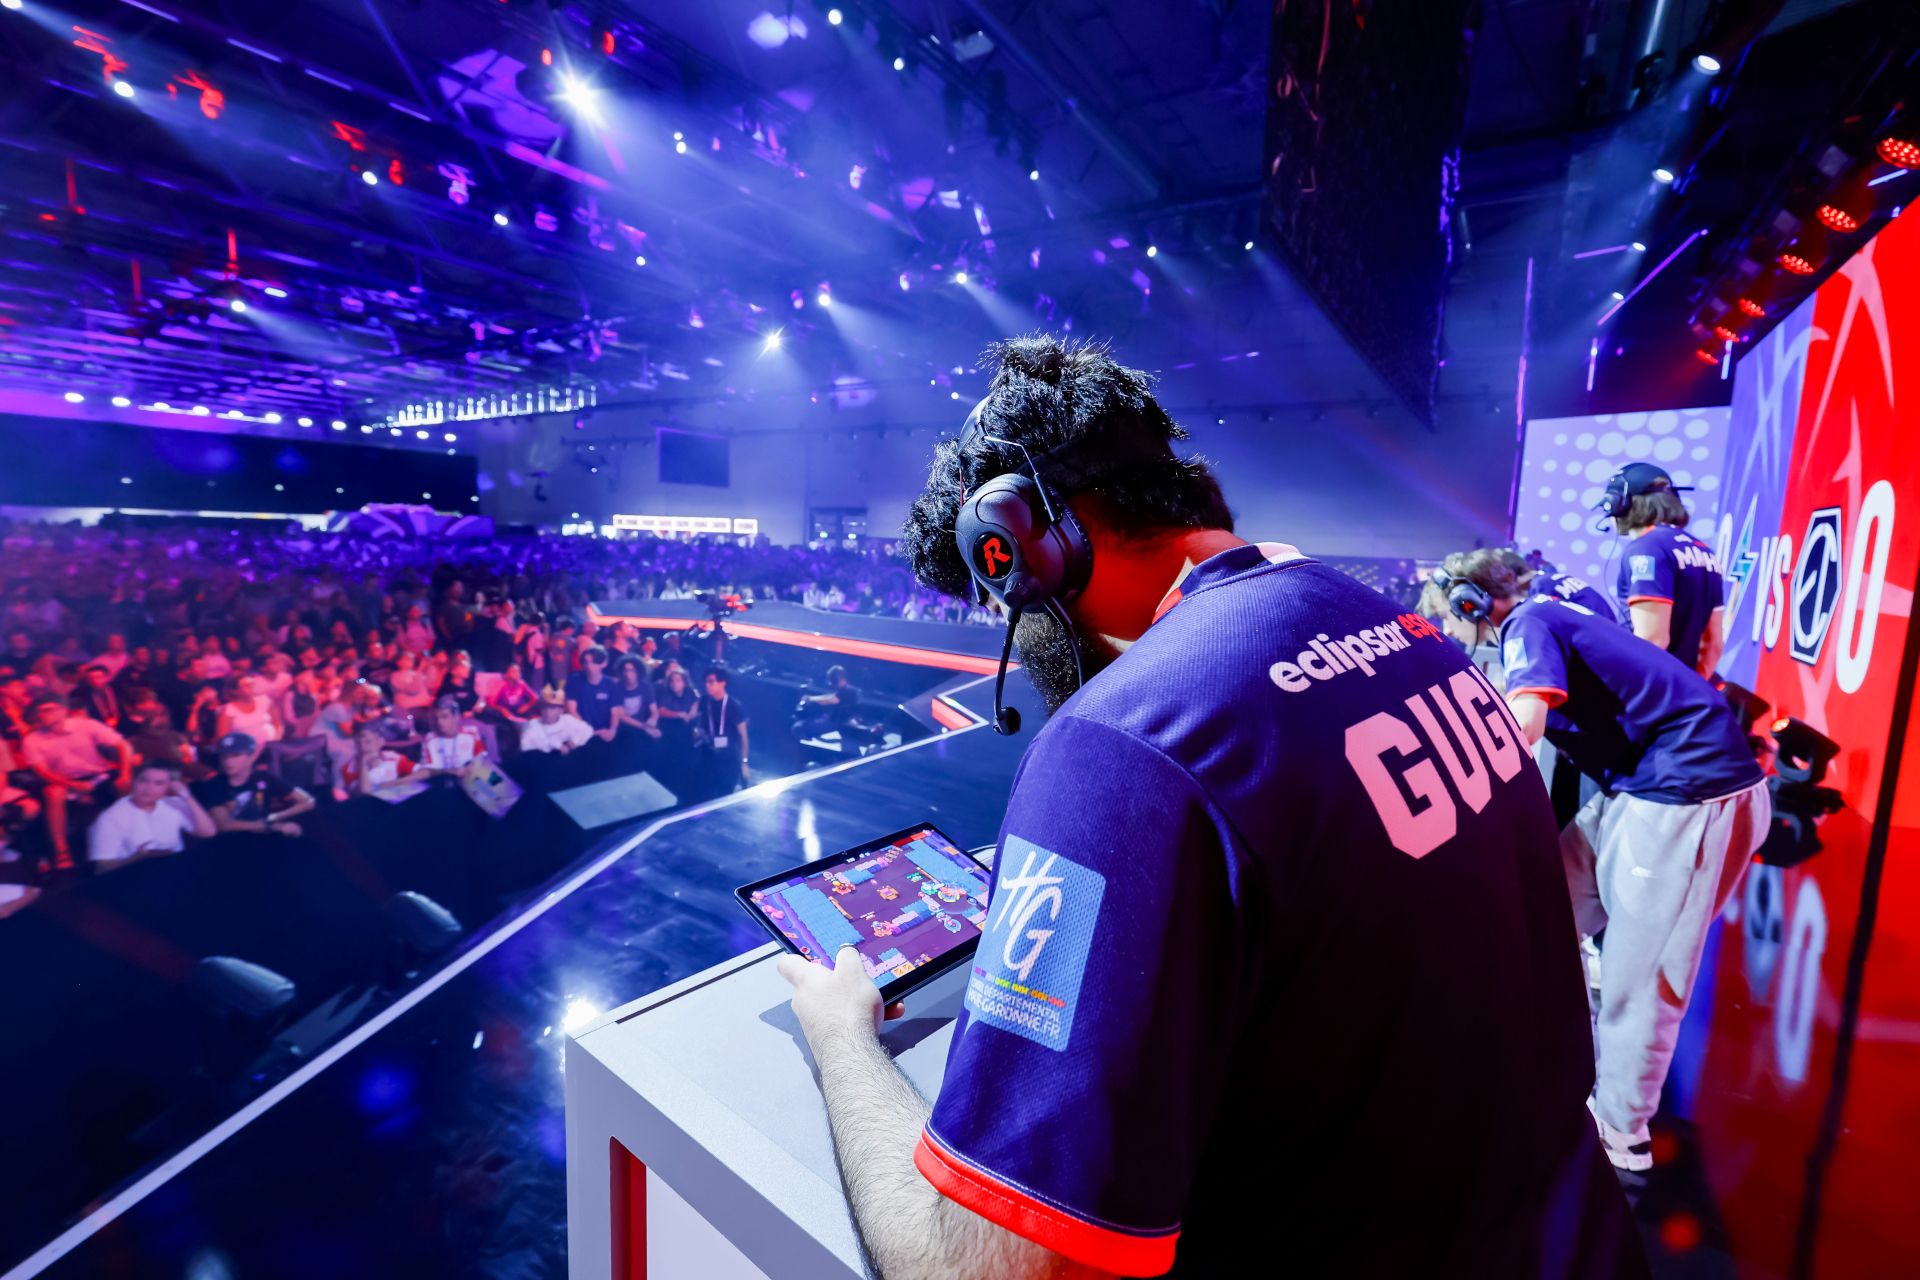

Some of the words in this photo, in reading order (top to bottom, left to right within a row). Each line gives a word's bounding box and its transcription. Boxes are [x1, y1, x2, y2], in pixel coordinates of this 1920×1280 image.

[1269, 620, 1411, 693] eclipsar
[1752, 534, 1792, 649] VS
[1836, 480, 1895, 694] 0
